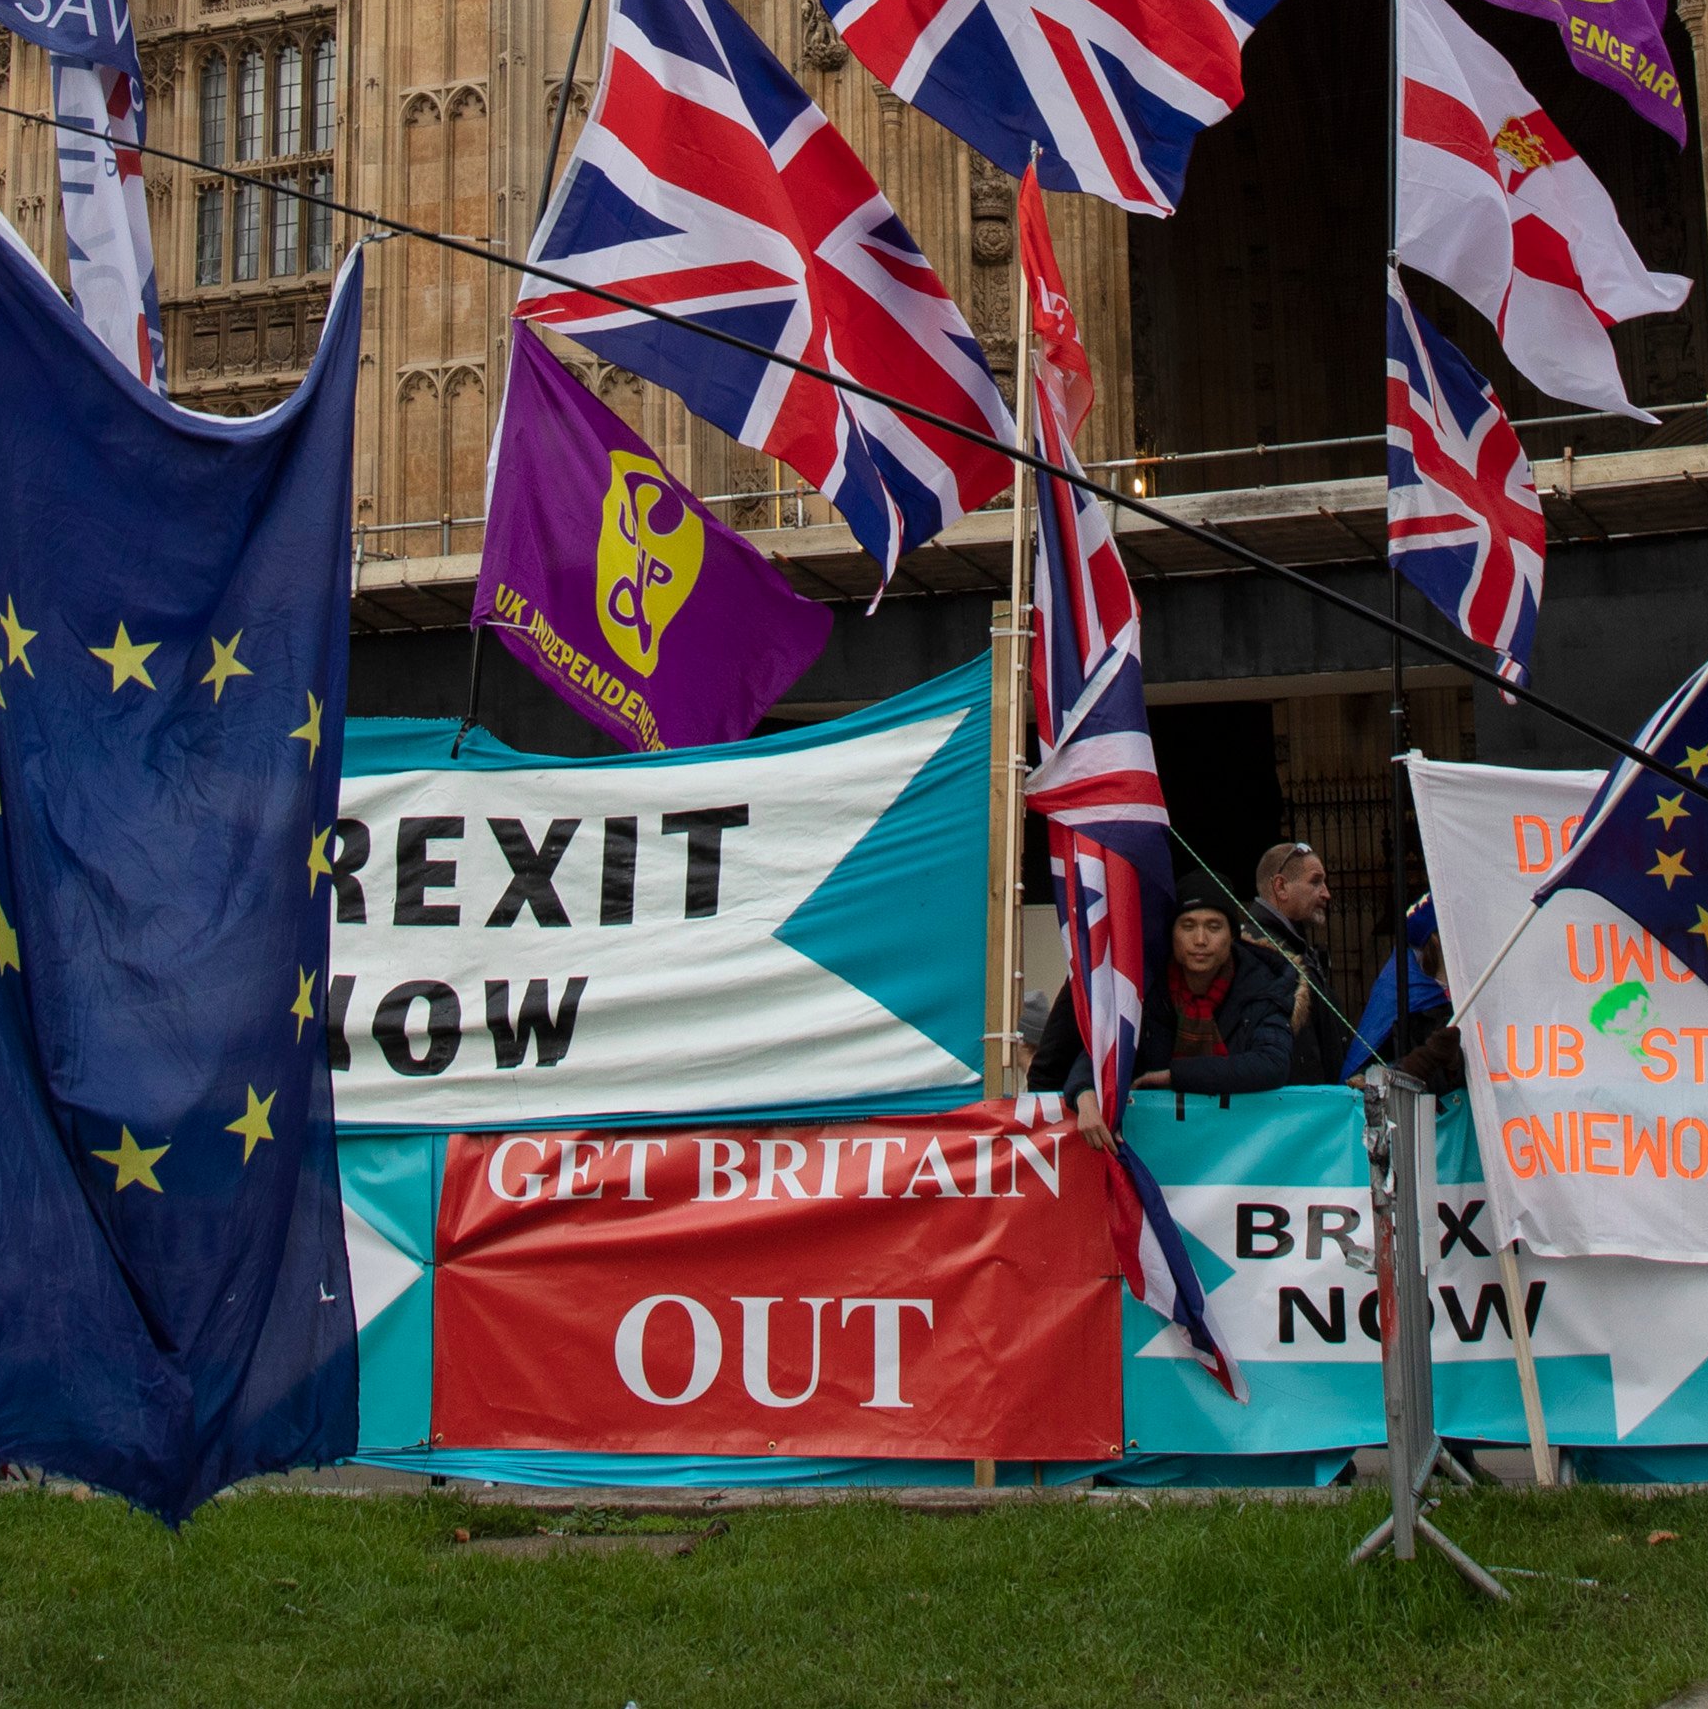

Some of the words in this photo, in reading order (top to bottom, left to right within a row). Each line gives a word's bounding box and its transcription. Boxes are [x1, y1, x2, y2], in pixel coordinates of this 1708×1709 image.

[495, 582, 528, 625] UK
[528, 609, 657, 742] INDEPENDENCE
[332, 803, 750, 929] REXIT
[1476, 1020, 1586, 1083] LUB
[487, 1137, 668, 1203] GET
[691, 1132, 1065, 1203] BRITAIN
[614, 1294, 934, 1408] OUT
